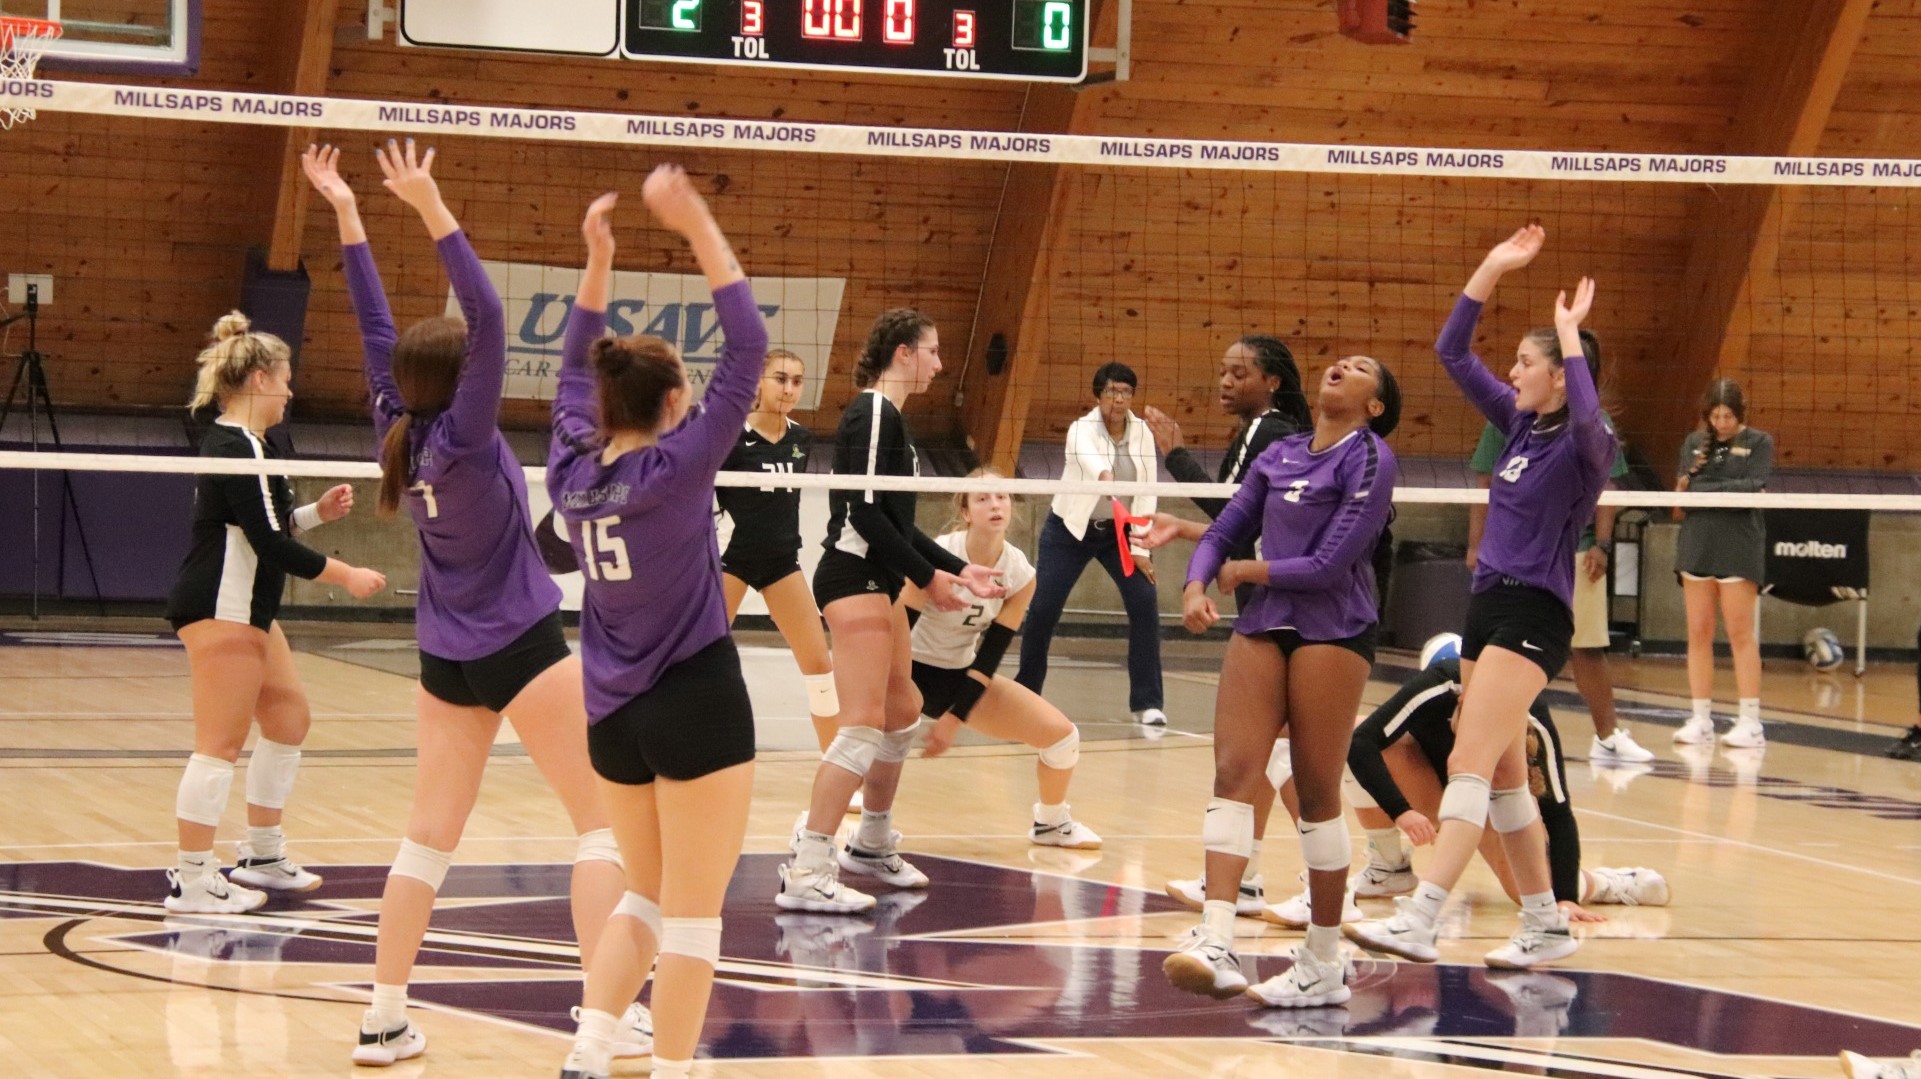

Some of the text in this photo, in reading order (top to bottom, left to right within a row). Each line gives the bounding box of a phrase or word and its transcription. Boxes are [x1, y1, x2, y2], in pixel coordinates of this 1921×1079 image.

[743, 1, 761, 32] 3
[1043, 2, 1070, 49] 0
[955, 13, 973, 44] 3
[731, 36, 770, 59] TOL
[943, 48, 980, 70] TOL
[0, 80, 54, 98] JORS
[115, 89, 323, 118] MILLSAPS MAJORS
[378, 105, 577, 132] MILLSAPS MAJORS
[626, 118, 817, 143] MILLSAPS MAJORS
[866, 130, 1051, 154] MILLSAPS MAJORS
[1100, 140, 1280, 163] MILLSAPS MAJORS
[1327, 149, 1505, 169] MILLSAPS MAJORS
[1551, 156, 1727, 174] MILLSAPS MAJORS
[1773, 161, 1921, 178] MILLSAPS MAJO
[504, 358, 551, 378] CAR
[581, 514, 633, 582] 15
[1774, 540, 1847, 559] molten
[961, 603, 985, 627] 2
